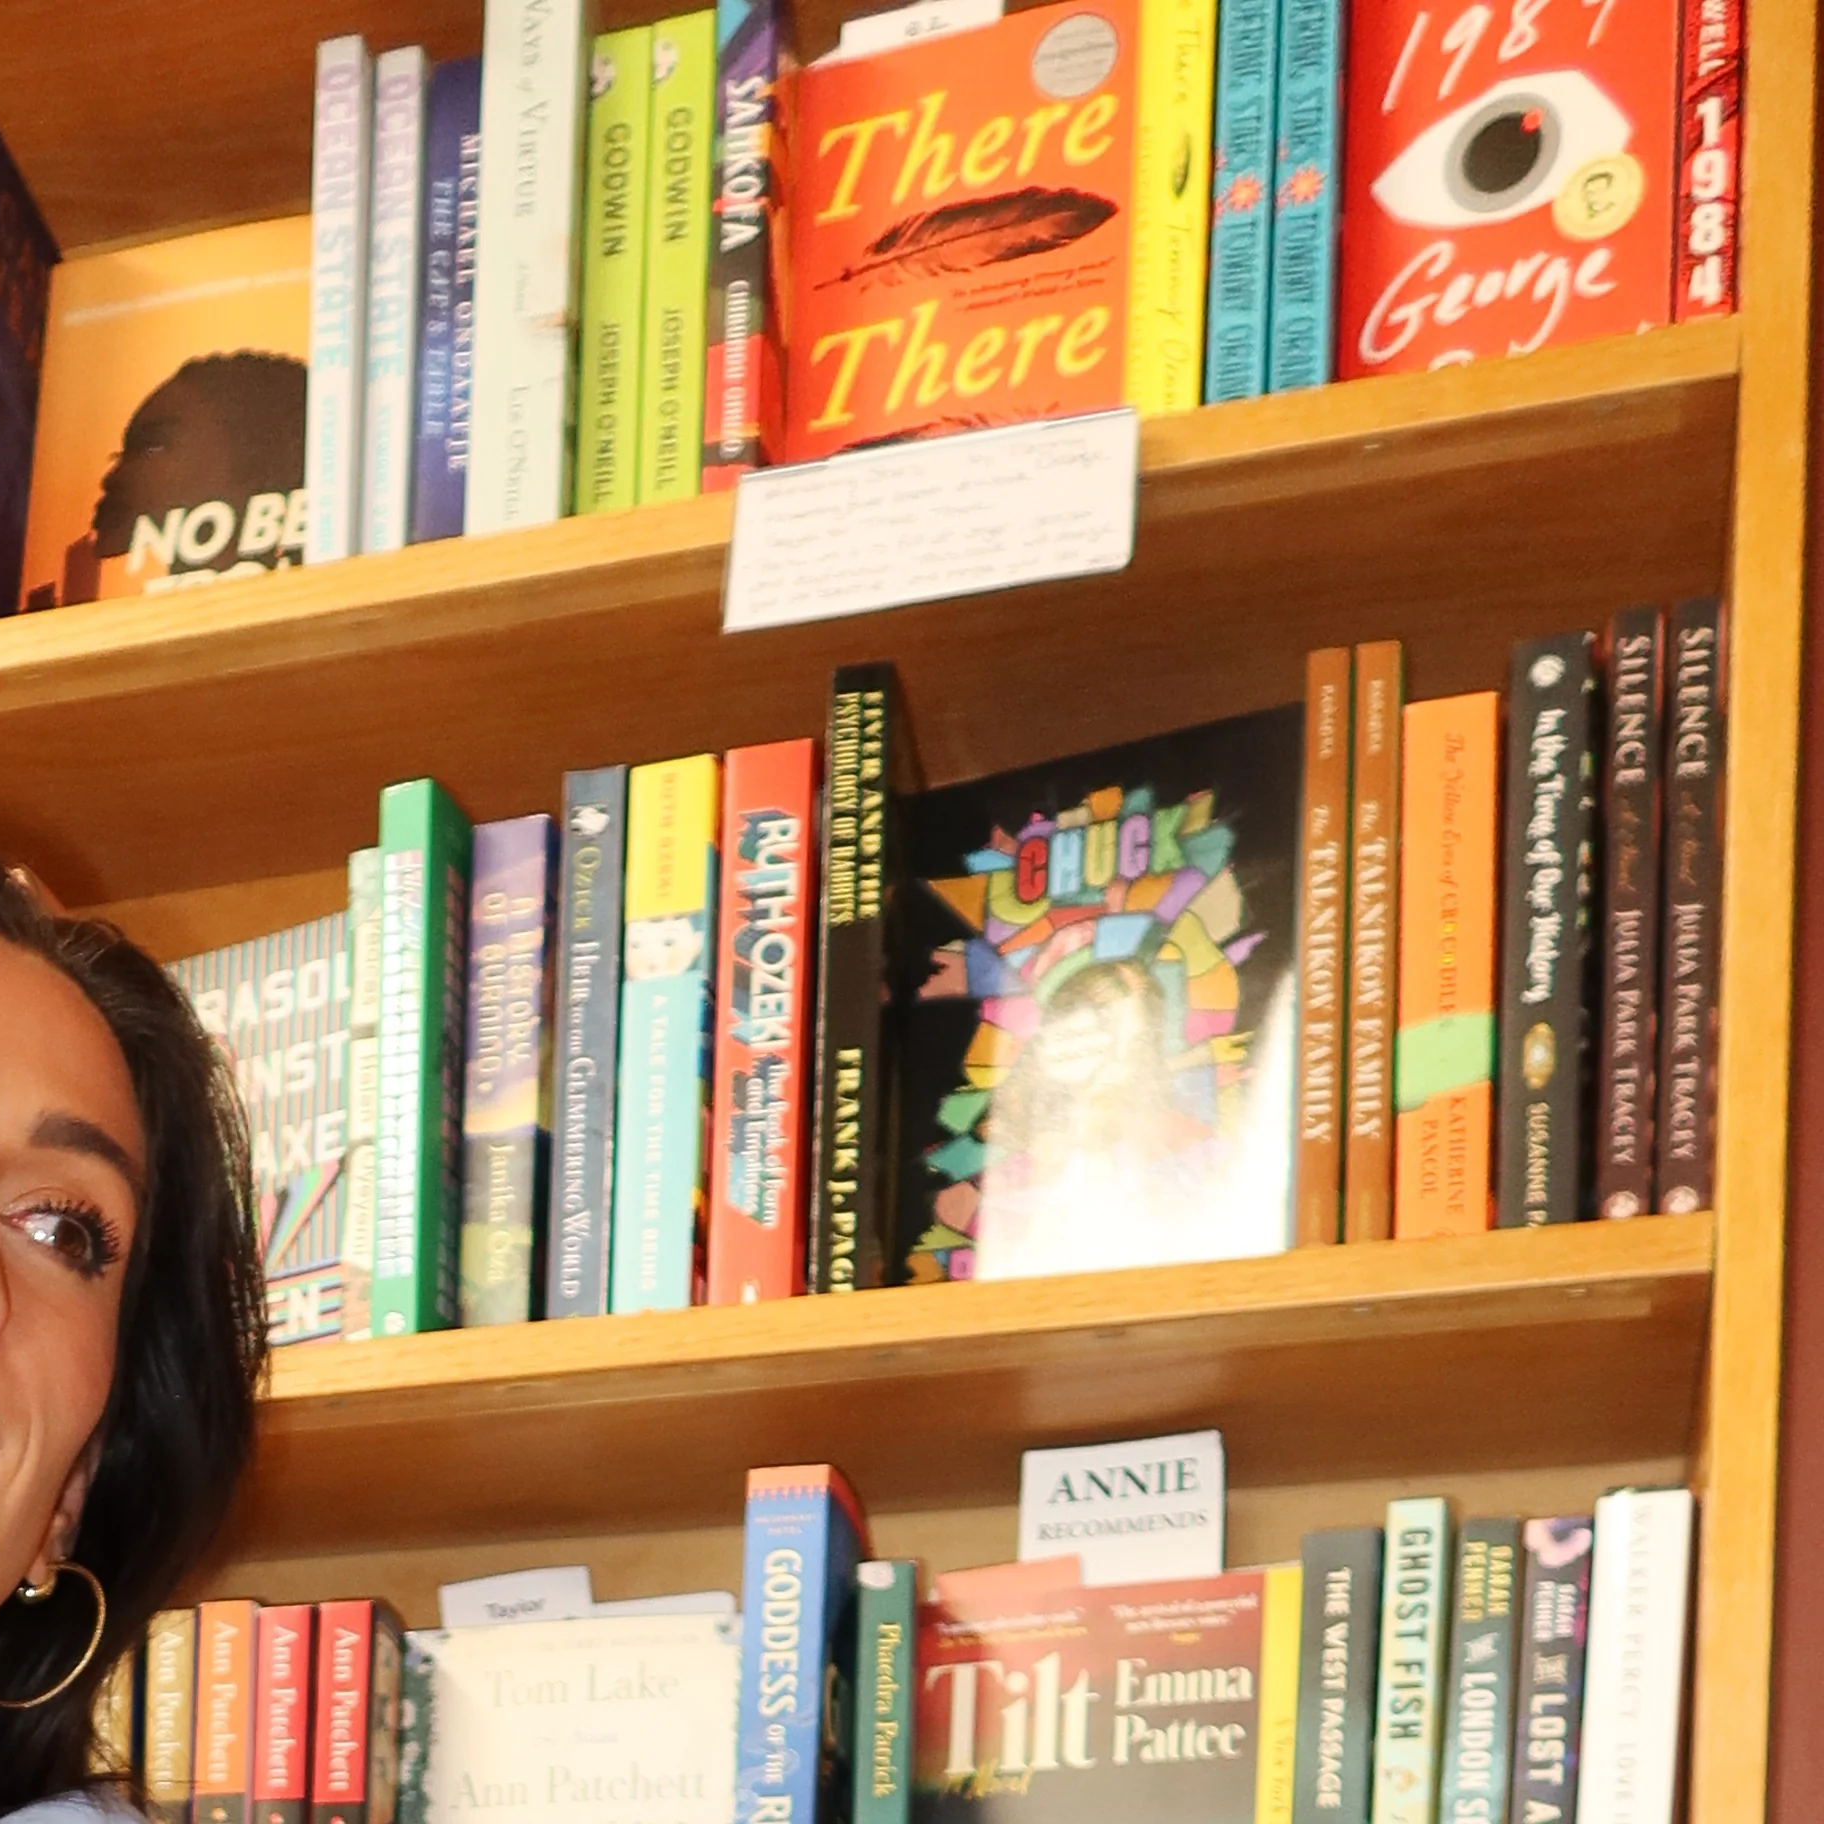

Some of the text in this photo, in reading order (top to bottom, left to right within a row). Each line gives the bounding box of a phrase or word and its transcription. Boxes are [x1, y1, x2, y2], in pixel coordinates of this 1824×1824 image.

[431, 179, 453, 235] THE
[812, 90, 1120, 225] There
[1688, 96, 1729, 306] 1984
[368, 74, 415, 386] OCEAN STATE
[592, 122, 633, 506] GODWIN JOSEPH O'NEILL
[654, 107, 694, 492] GODWIN JOSEPH O'NEILL
[1358, 241, 1616, 364] George
[423, 350, 450, 439] TABLE
[807, 300, 1112, 434] There
[125, 499, 234, 578] NO
[829, 691, 862, 926] PSYCHOLOGY OF RABBITS
[1016, 804, 1187, 903] CHUCK
[750, 816, 802, 1047] RUTH OZEKI
[1355, 836, 1387, 1007] TALNIKOV
[1669, 626, 1713, 1162] SILENCE JULIA PARK TRACEY
[831, 1048, 863, 1172] FRANK
[1351, 1017, 1385, 1140] FAMILY
[254, 1110, 348, 1177] AXE
[826, 1176, 858, 1204] J.
[1419, 1119, 1439, 1200] PANCOL
[1445, 1096, 1467, 1216] KATHERINE
[1525, 1102, 1550, 1204] SUSANNE
[486, 1143, 515, 1285] Janika Oza
[1036, 1508, 1210, 1543] RECOMMENDS
[1045, 1455, 1201, 1508] ANNIE
[484, 1597, 548, 1621] Taylor
[757, 1549, 803, 1717] GODDESS
[1324, 1567, 1351, 1616] THE
[1394, 1526, 1433, 1643] GHOST
[1460, 1540, 1489, 1623] PENNER
[1487, 1544, 1513, 1616] SARAH
[266, 1625, 300, 1789] Ann Patchett
[327, 1627, 361, 1792] Ann Patchett
[482, 1660, 682, 1709] Tom Lake
[871, 1620, 904, 1799] Phaedra Patrick
[1114, 1656, 1254, 1708] Emma
[1320, 1621, 1348, 1690] WEST
[1388, 1657, 1425, 1741] FISH
[762, 1749, 787, 1784] THE
[764, 1724, 787, 1746] OF
[925, 1650, 1100, 1776] Tilt
[1111, 1712, 1247, 1765] Pattee
[1315, 1697, 1344, 1810] PASSAGE
[1457, 1671, 1498, 1790] LONDON
[1526, 1692, 1569, 1786] LOST
